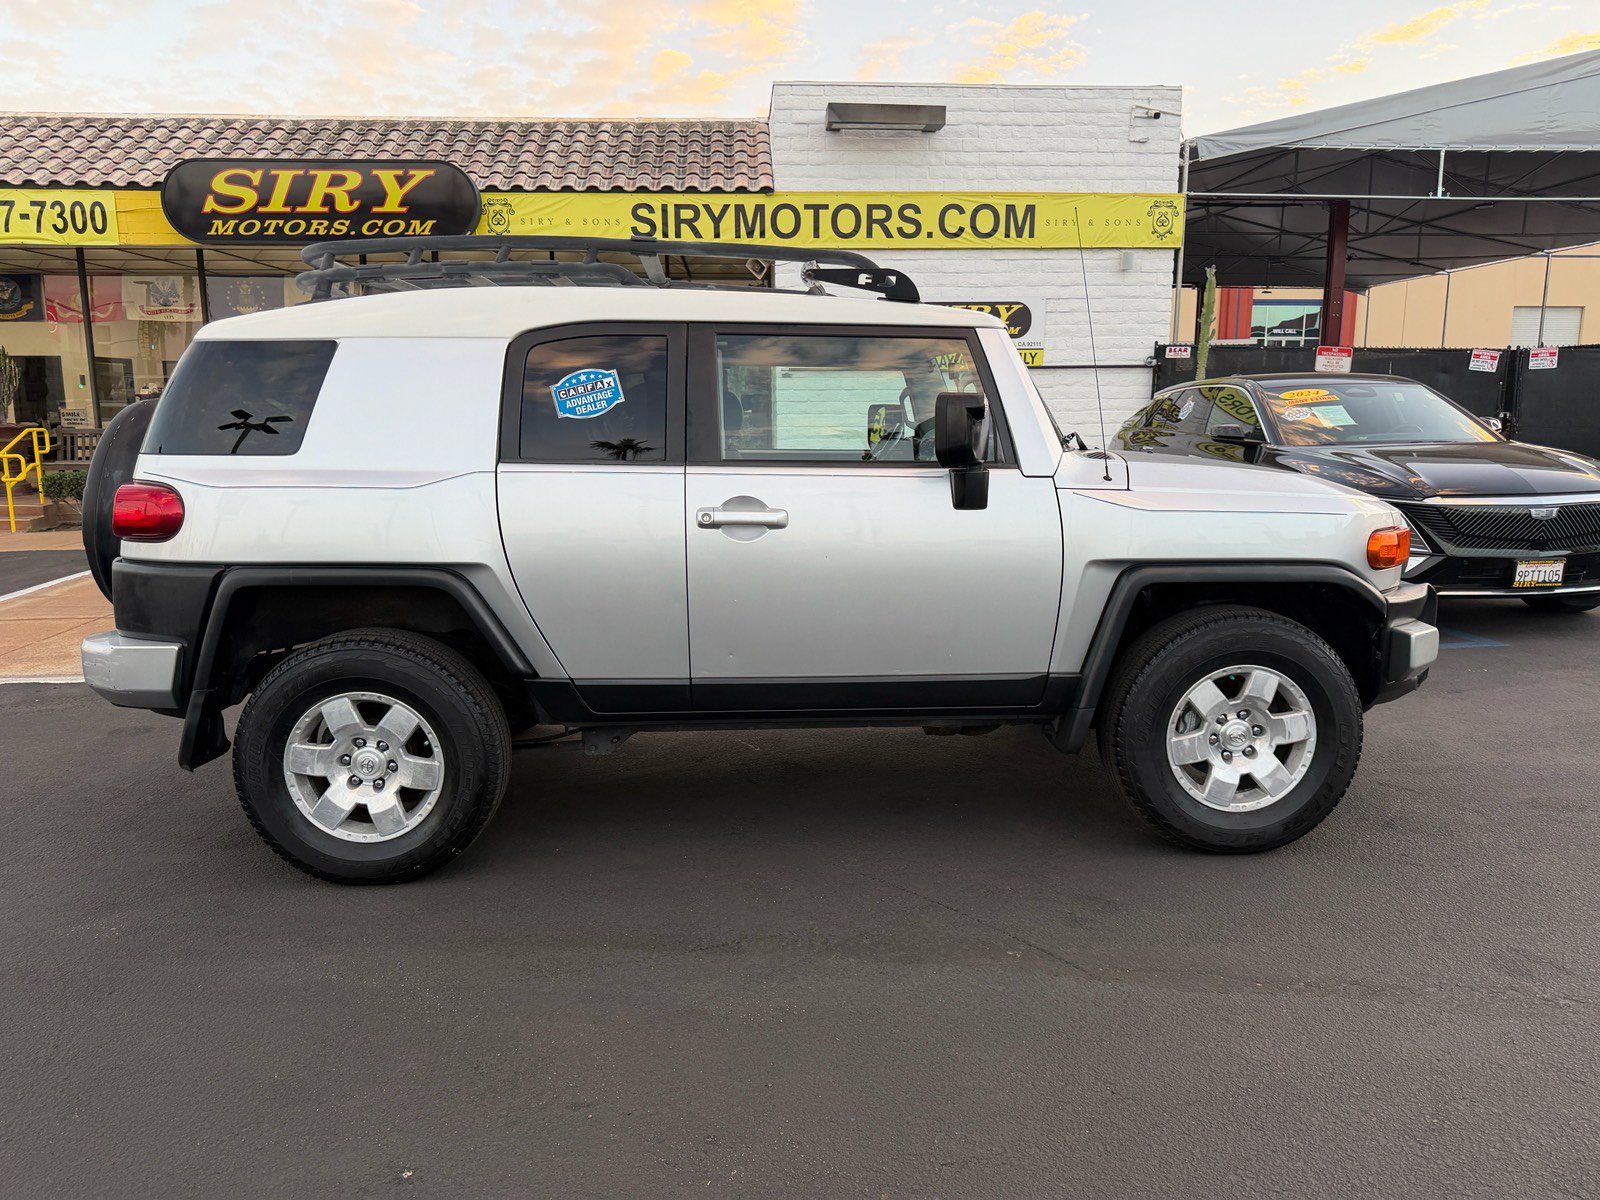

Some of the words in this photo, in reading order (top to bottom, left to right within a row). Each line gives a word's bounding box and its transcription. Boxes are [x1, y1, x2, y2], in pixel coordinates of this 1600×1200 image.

[202, 168, 436, 214] SIRY
[0, 200, 108, 235] 7-7300
[520, 217, 555, 226] SIRY
[565, 217, 572, 226] &
[582, 218, 622, 226] SONS
[630, 202, 1036, 239] SIRYMOTORS.COM
[1045, 219, 1078, 227] SIRY
[1088, 219, 1094, 227] &
[1105, 219, 1141, 227] SONS
[207, 219, 437, 236] MOTORS.COM
[559, 380, 613, 398] CARFAX
[566, 390, 613, 408] ADVANTAGE
[576, 400, 608, 415] DEALER
